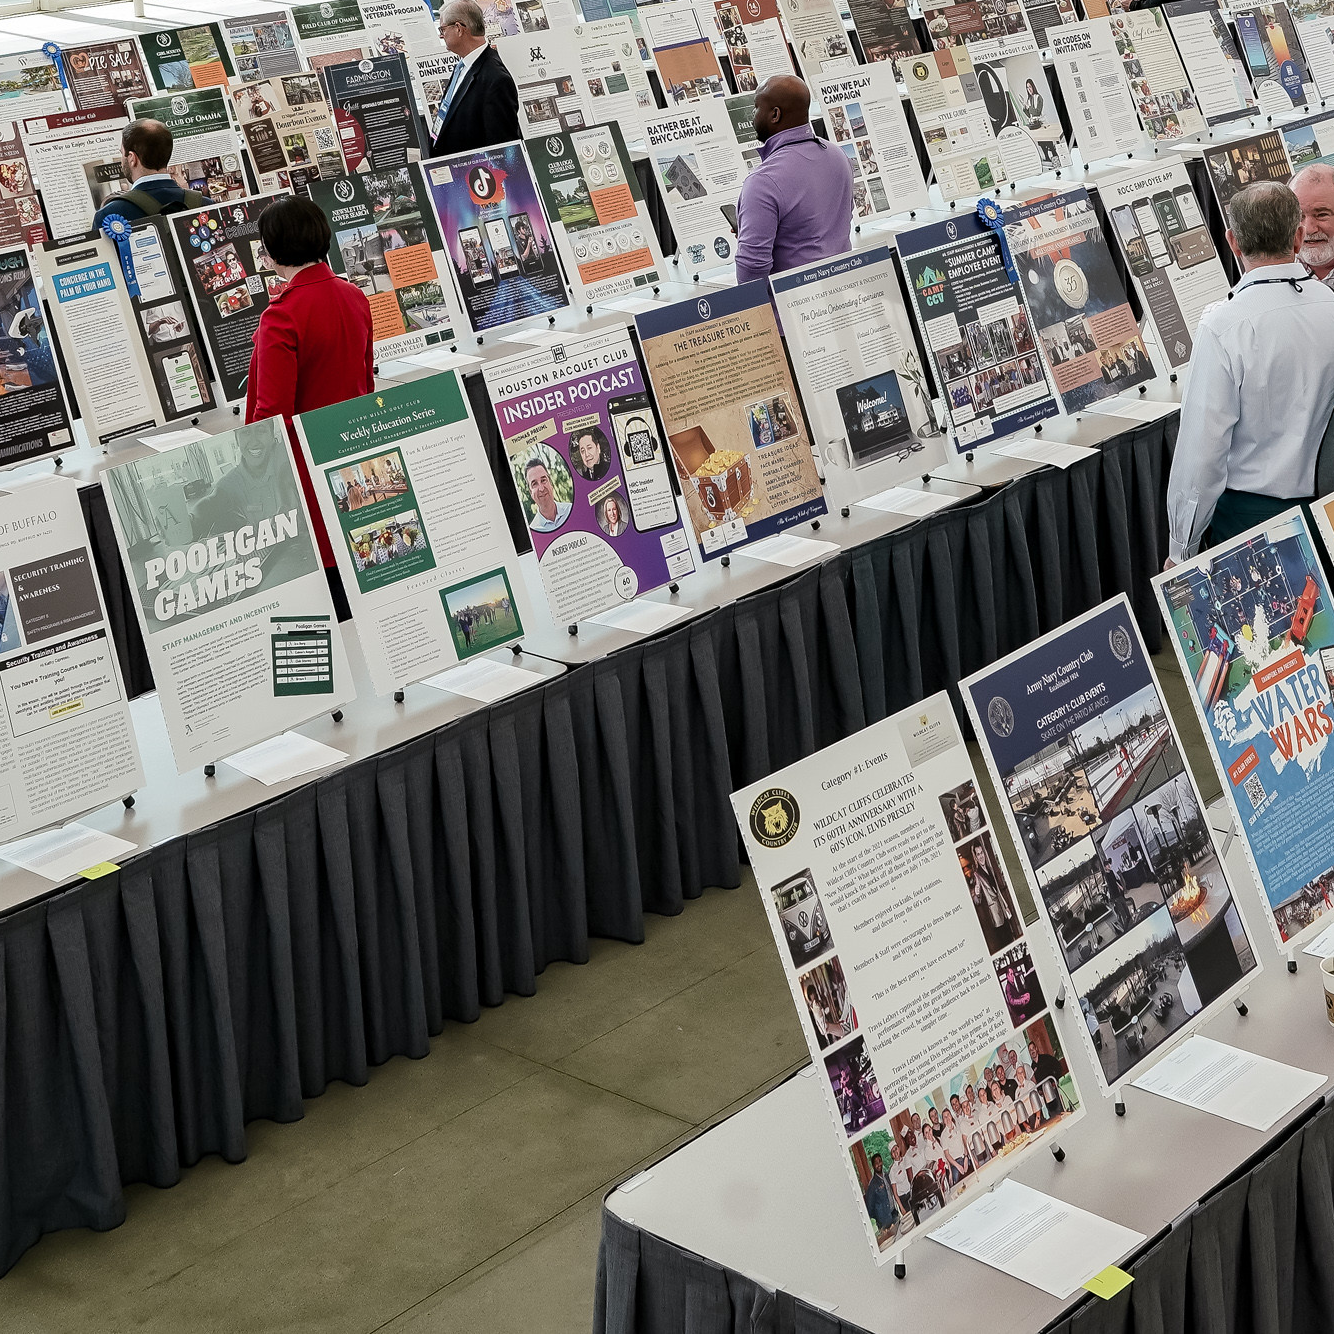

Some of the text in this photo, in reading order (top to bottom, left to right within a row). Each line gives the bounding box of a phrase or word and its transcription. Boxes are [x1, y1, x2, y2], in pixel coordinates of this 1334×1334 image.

[363, 4, 396, 16] WOUNDED
[364, 4, 424, 21] VETERAN PROGRAM
[1053, 33, 1091, 47] QR CODES ON
[1056, 41, 1092, 54] INVITATIONS
[89, 52, 132, 70] PIE SALE
[417, 59, 440, 69] WILLY
[346, 70, 391, 85] FARMINGTON
[419, 66, 445, 78] DINNER
[821, 78, 871, 98] NOW WE PLAY
[824, 90, 861, 104] CAMPAIGN
[276, 115, 327, 129] Bourbon Events
[647, 116, 704, 135] RATHER BE AT
[938, 109, 968, 122] STYLE GUIDE
[649, 125, 713, 146] BHYC CAMPAIGN
[1117, 172, 1173, 195] ROCC EMPLOYEE APP
[332, 210, 369, 222] COVER SEARCH
[333, 205, 366, 216] NEWSLETTER
[948, 255, 1001, 279] EMPLOYEE EVENT
[923, 284, 944, 297] CAMP
[927, 293, 944, 306] CCV
[674, 322, 751, 353] THE TREASURE TROVE
[498, 350, 628, 396] HOUSTON RACQUET CLUB
[504, 368, 634, 423] INSIDER PODCAST
[340, 409, 436, 441] Weekly Education Series
[12, 511, 57, 531] BUFFALO
[144, 509, 301, 591] POOLIGAN
[14, 556, 84, 582] SECURITY TRAINING
[20, 585, 60, 601] AWARENESS
[153, 557, 266, 623] GAMES
[1027, 650, 1094, 695] Army Navy Country Club
[1252, 665, 1325, 735] WATER
[1271, 702, 1334, 761] WARS
[822, 753, 888, 791] Category #1: Events
[814, 773, 914, 830] WILDCAT CLIFFS CELEBRATES
[854, 879, 942, 932] Members enjoyed cocktails, food stations,
